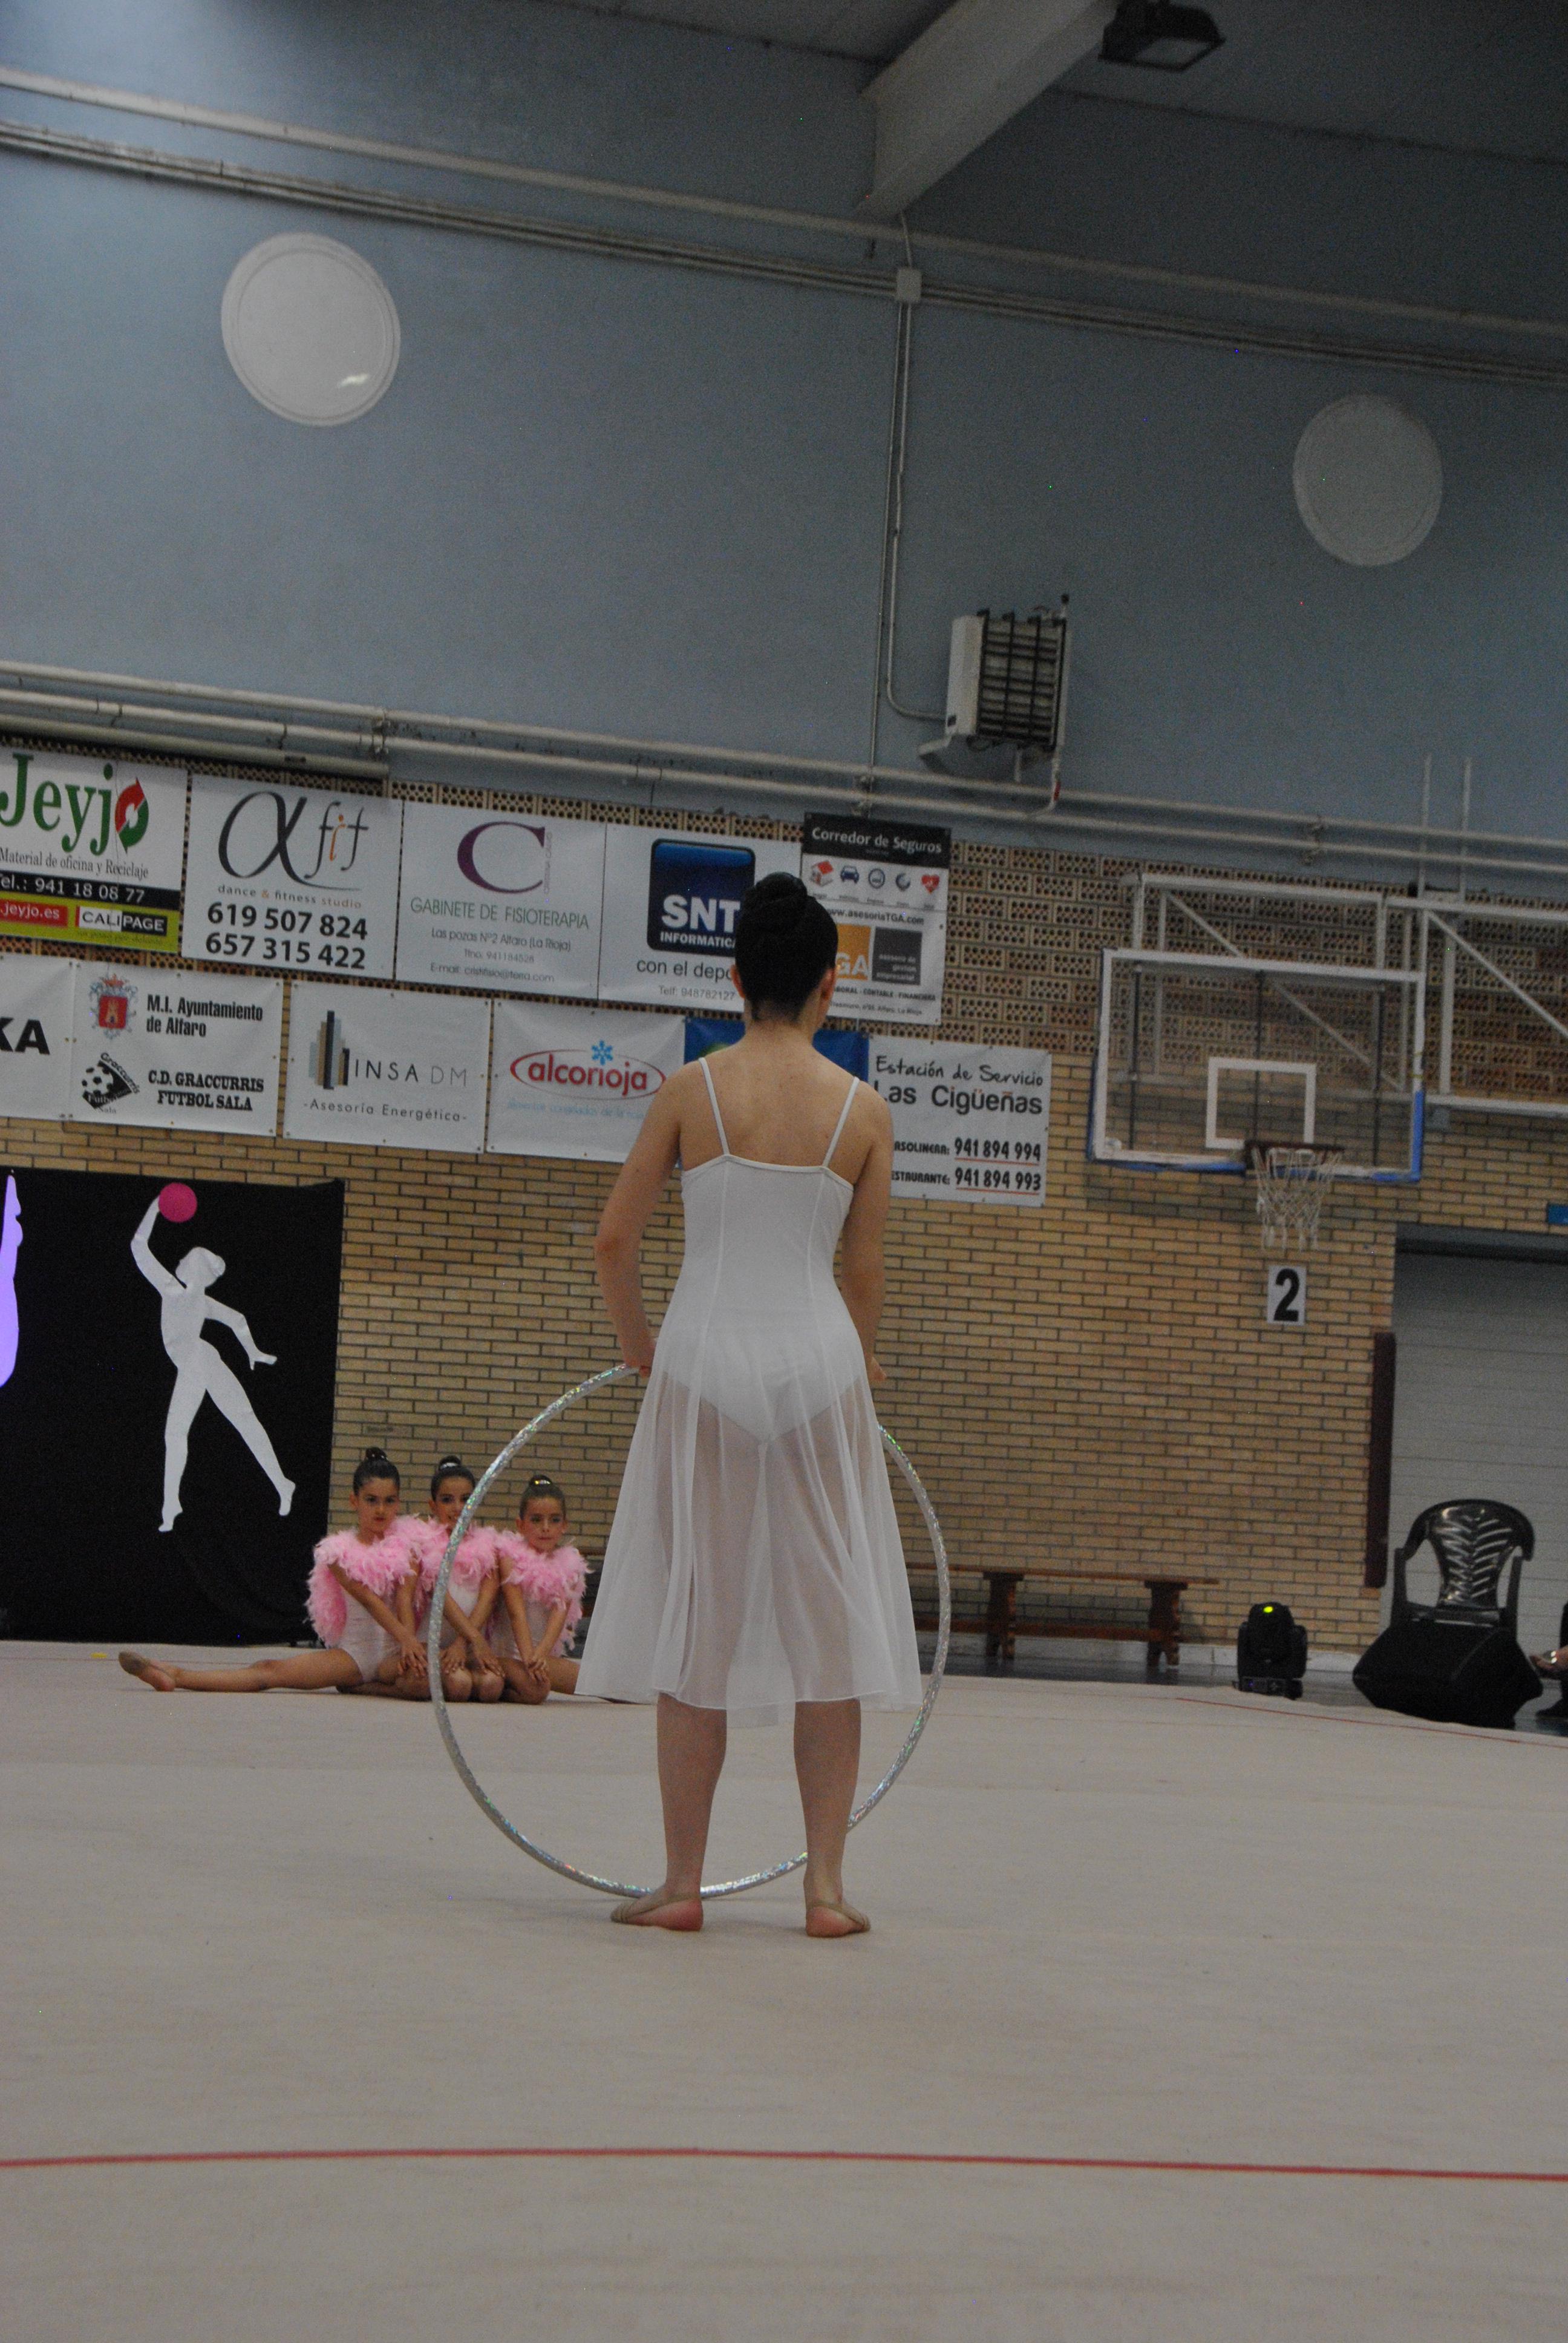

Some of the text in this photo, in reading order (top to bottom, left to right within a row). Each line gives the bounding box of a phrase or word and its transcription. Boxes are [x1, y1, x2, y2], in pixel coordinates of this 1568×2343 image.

[811, 827, 942, 854] Corredor de Seguros
[0, 848, 149, 881] Material de oficina y Reciclaje
[457, 821, 545, 894] C
[35, 877, 65, 895] 941
[73, 882, 93, 897] 18
[99, 885, 119, 901] 08
[126, 888, 145, 903] 77
[218, 884, 362, 908] dance & fitness studio
[82, 911, 165, 931] CALIPAGE
[207, 901, 368, 940] 619 507 824
[411, 896, 589, 929] GABINETE DE FISIOTERAPIA
[661, 894, 741, 933] SNT
[206, 932, 365, 969] 657 315 422
[431, 927, 447, 938] Las
[449, 930, 477, 942] pozas
[500, 936, 528, 947] Alfaro
[529, 937, 543, 949] (La
[546, 940, 571, 952] Rioja)
[660, 931, 736, 949] INFORMATIC
[636, 959, 667, 974] con
[673, 960, 687, 976] el
[147, 994, 263, 1021] M.I. Ayuntamiento
[146, 1016, 206, 1037] de Alfaro
[148, 1070, 264, 1092] C.D. GRACCURRIS
[354, 1059, 467, 1087] INSA DM
[876, 1055, 1044, 1086] Estación de Servicio
[157, 1090, 253, 1111] FUTBOL SALA
[931, 1085, 1043, 1115] Cigüeñas
[894, 1136, 1041, 1161] ASOLINERA: 941 894 994
[892, 1167, 1042, 1191] ESTAURANTE: 941 894 993
[1273, 1268, 1299, 1323] 2
